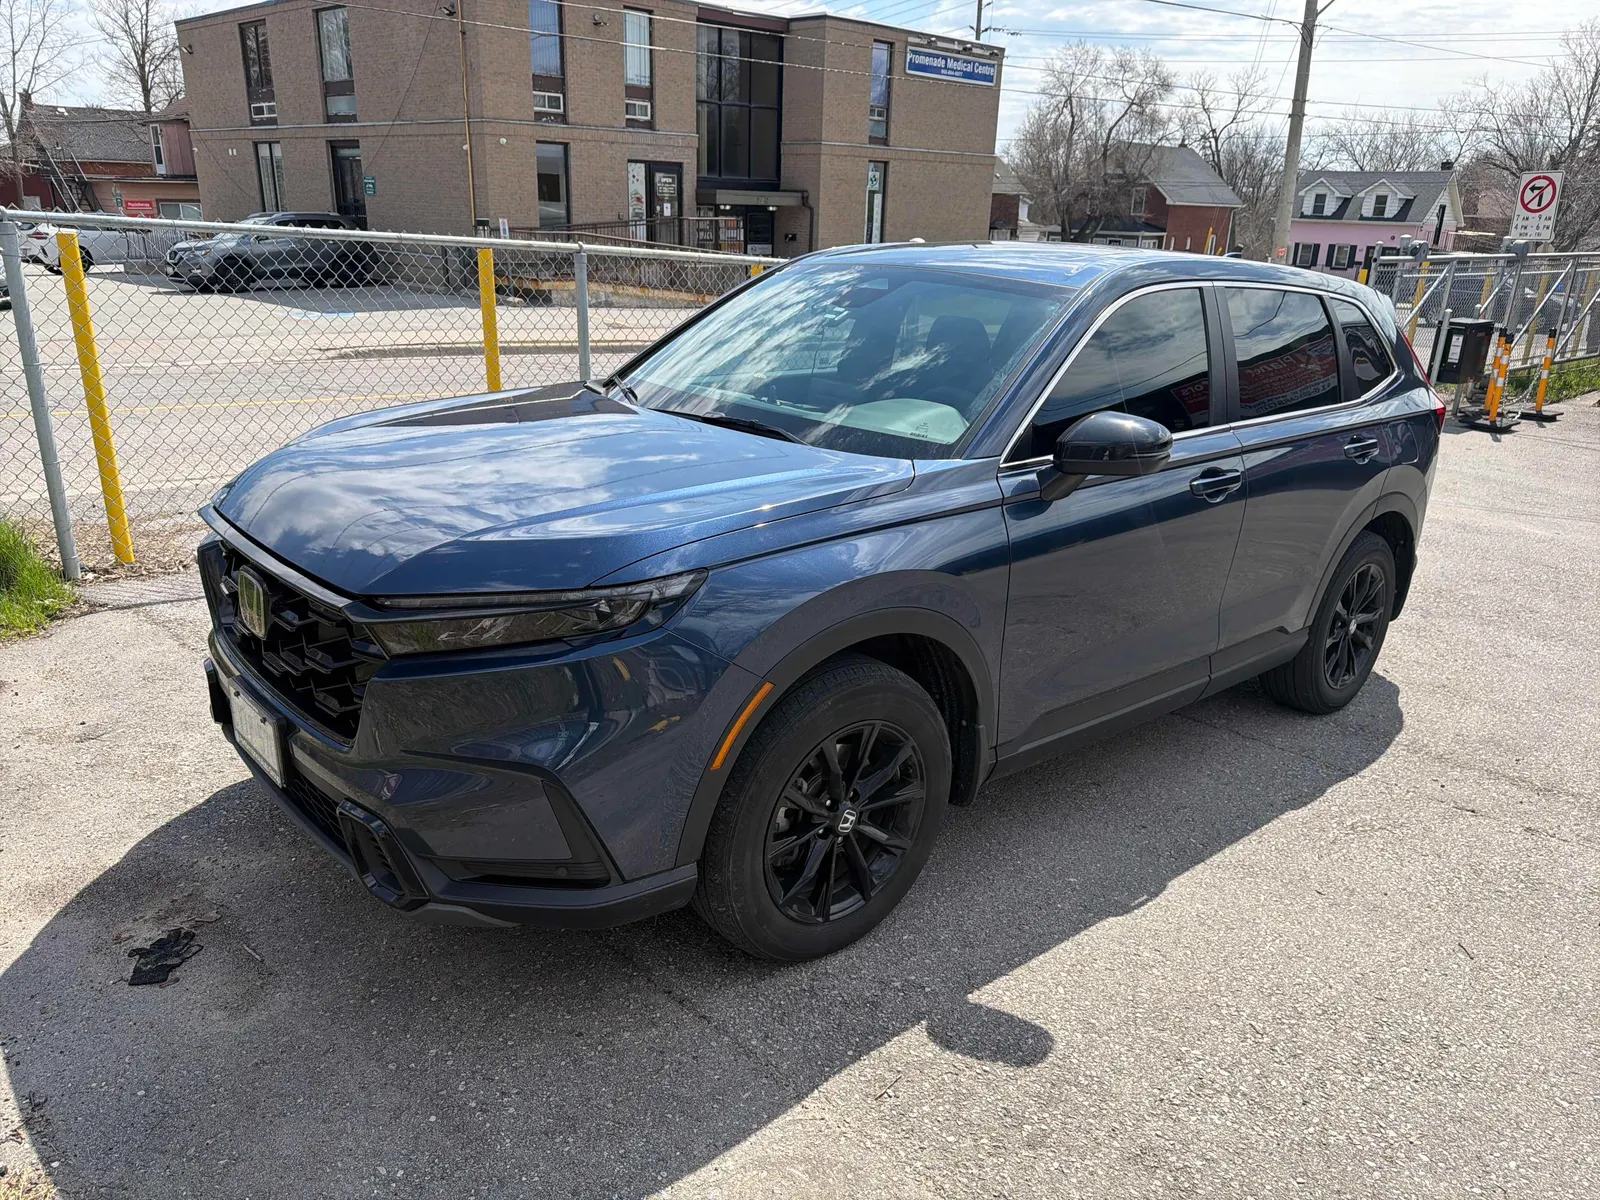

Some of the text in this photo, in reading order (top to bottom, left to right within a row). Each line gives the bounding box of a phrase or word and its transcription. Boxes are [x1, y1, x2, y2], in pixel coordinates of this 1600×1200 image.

[907, 52, 994, 76] Promenade Medical Centre
